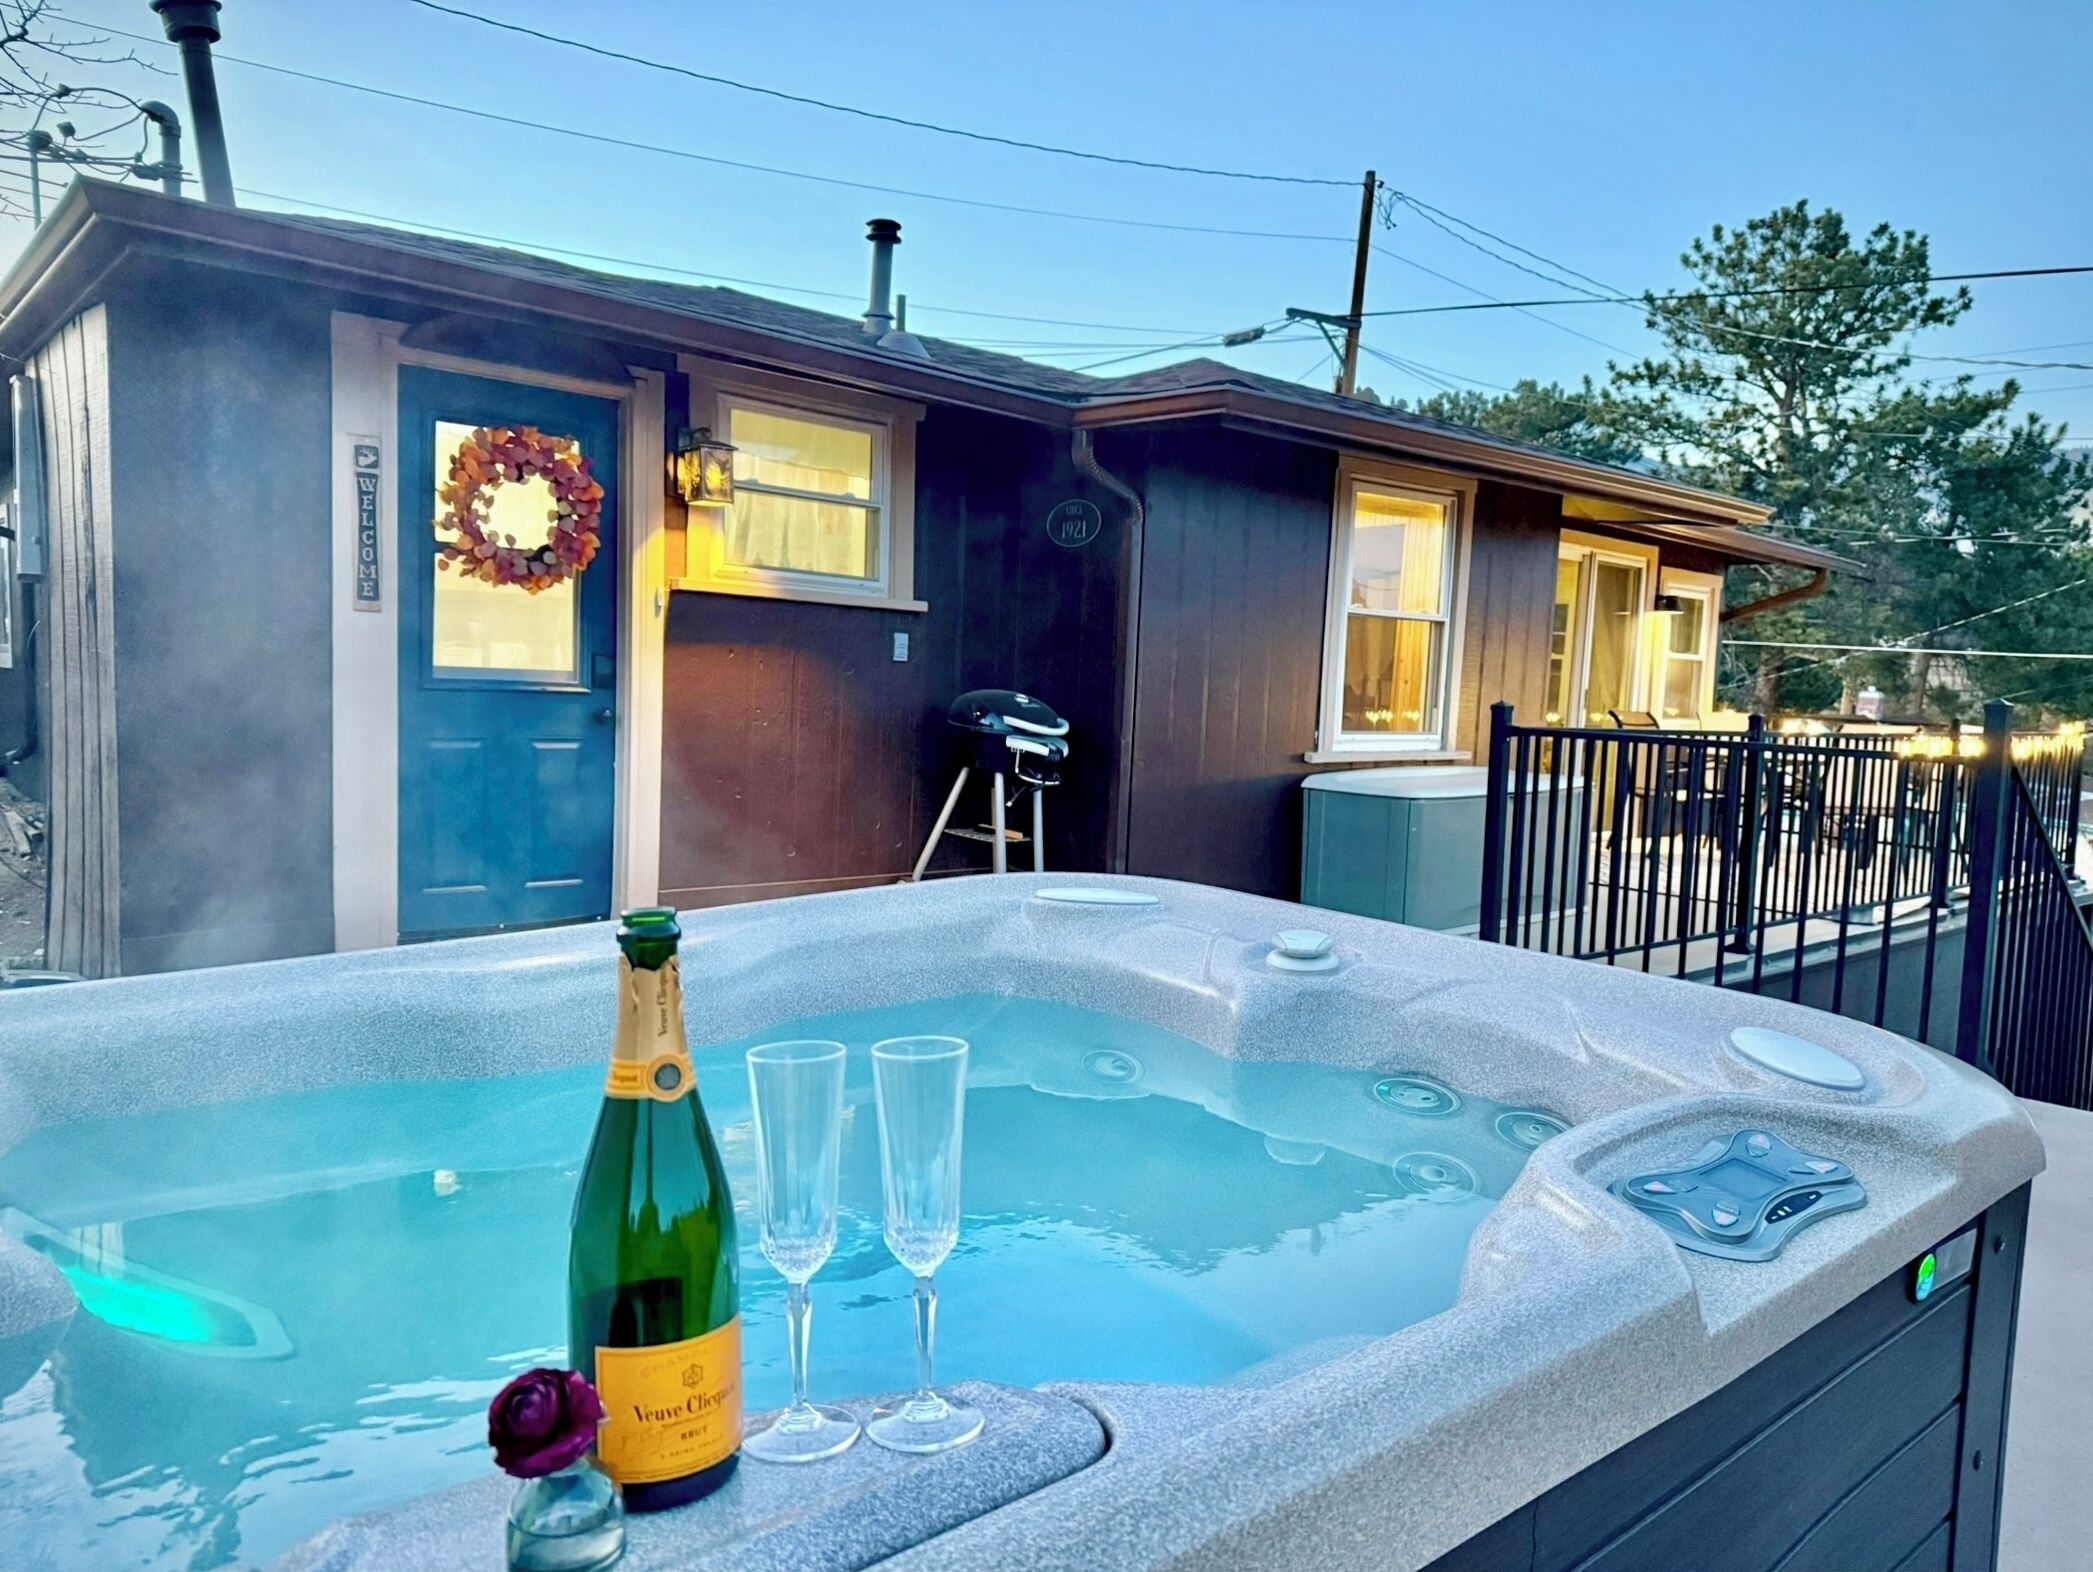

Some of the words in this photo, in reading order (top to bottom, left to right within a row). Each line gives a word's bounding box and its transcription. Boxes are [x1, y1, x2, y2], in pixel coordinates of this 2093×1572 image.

[358, 477, 377, 598] WELCOME
[1062, 519, 1087, 540] 1921
[633, 1404, 683, 1423] Veuve
